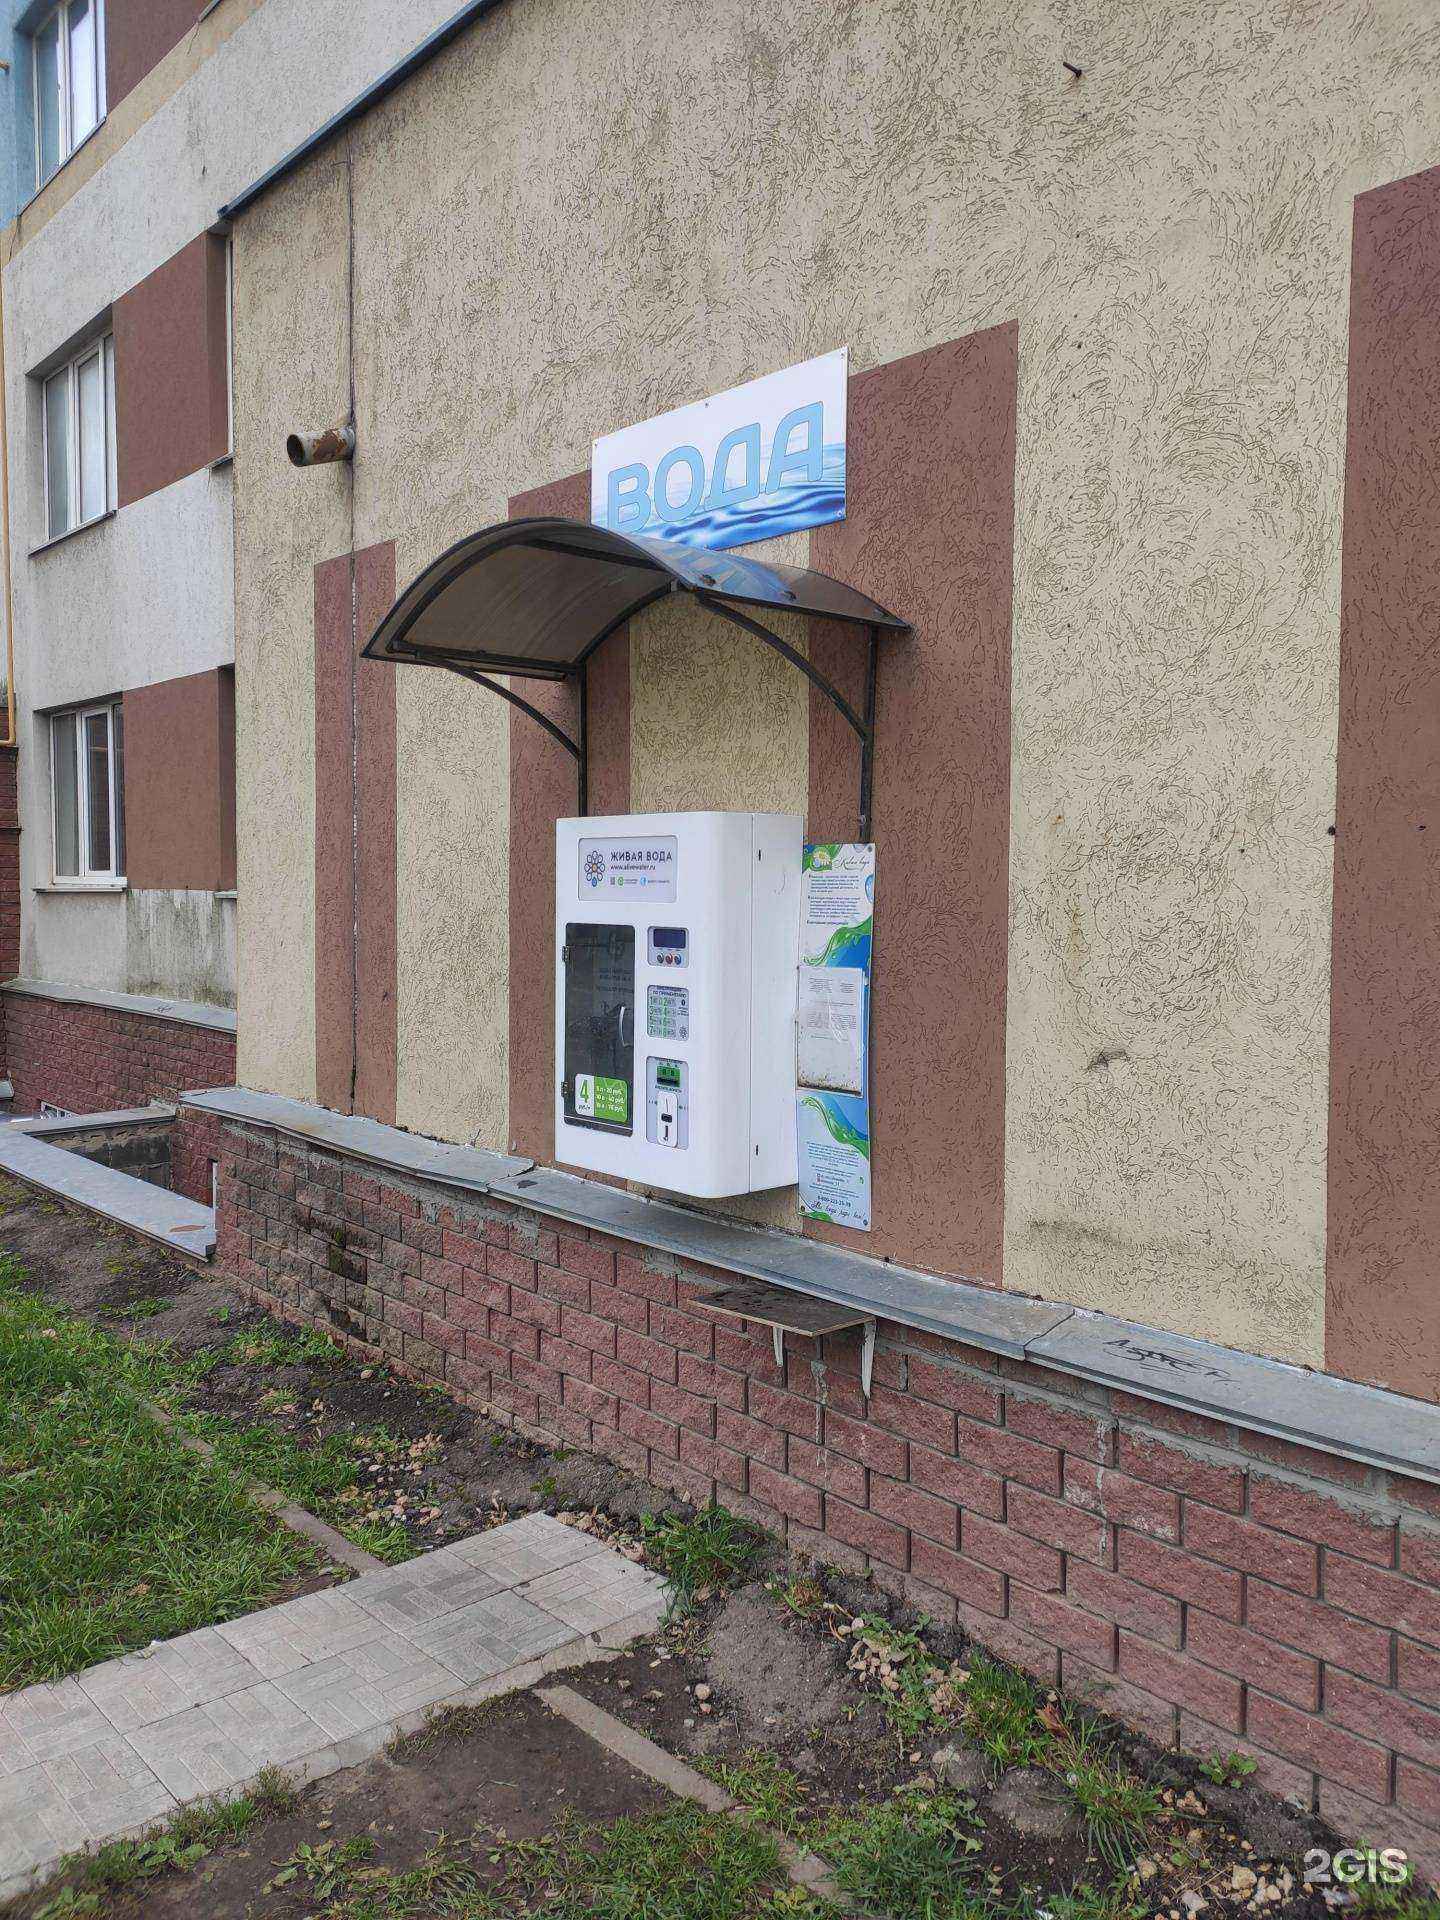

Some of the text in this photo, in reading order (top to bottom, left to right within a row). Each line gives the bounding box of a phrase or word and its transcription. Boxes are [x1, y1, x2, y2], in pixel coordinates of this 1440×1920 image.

[607, 400, 824, 533] ВОДА
[610, 851, 673, 863] ЖИВАЯ ВОДА
[579, 1079, 590, 1104] 4
